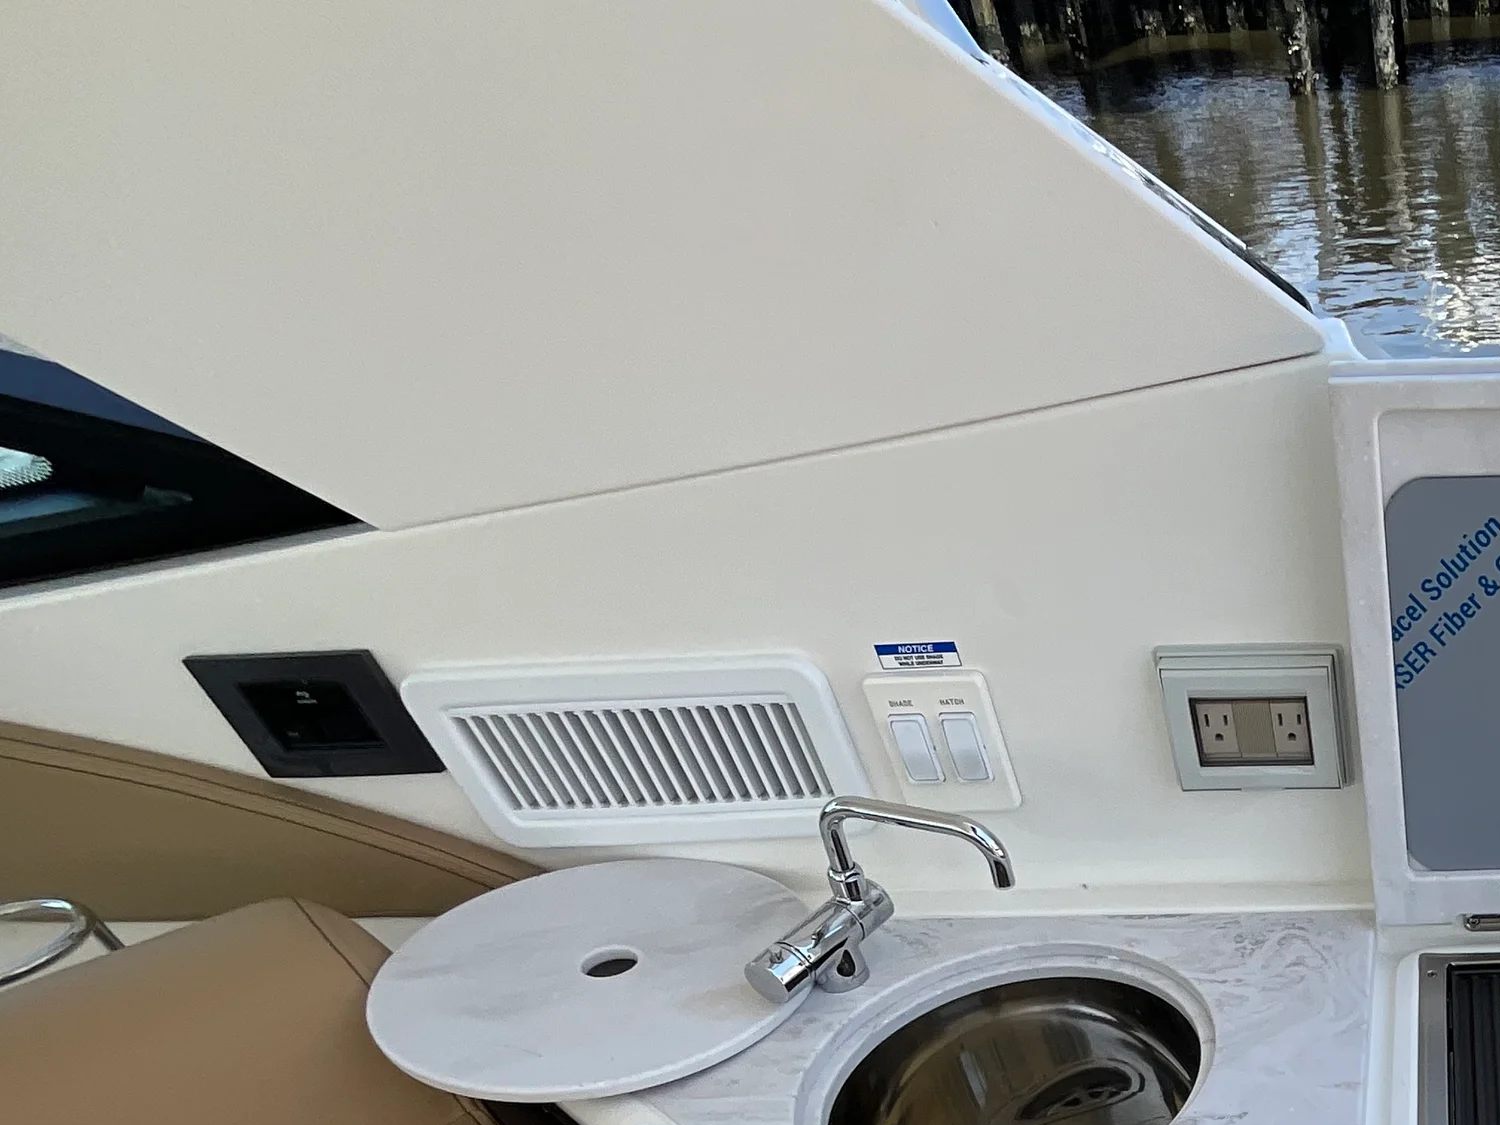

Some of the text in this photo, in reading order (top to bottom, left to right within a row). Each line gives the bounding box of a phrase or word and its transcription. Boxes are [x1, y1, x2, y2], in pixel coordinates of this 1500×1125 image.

[1429, 592, 1482, 647] Fiber
[898, 644, 934, 654] NOTICE
[939, 698, 965, 706] HATCH
